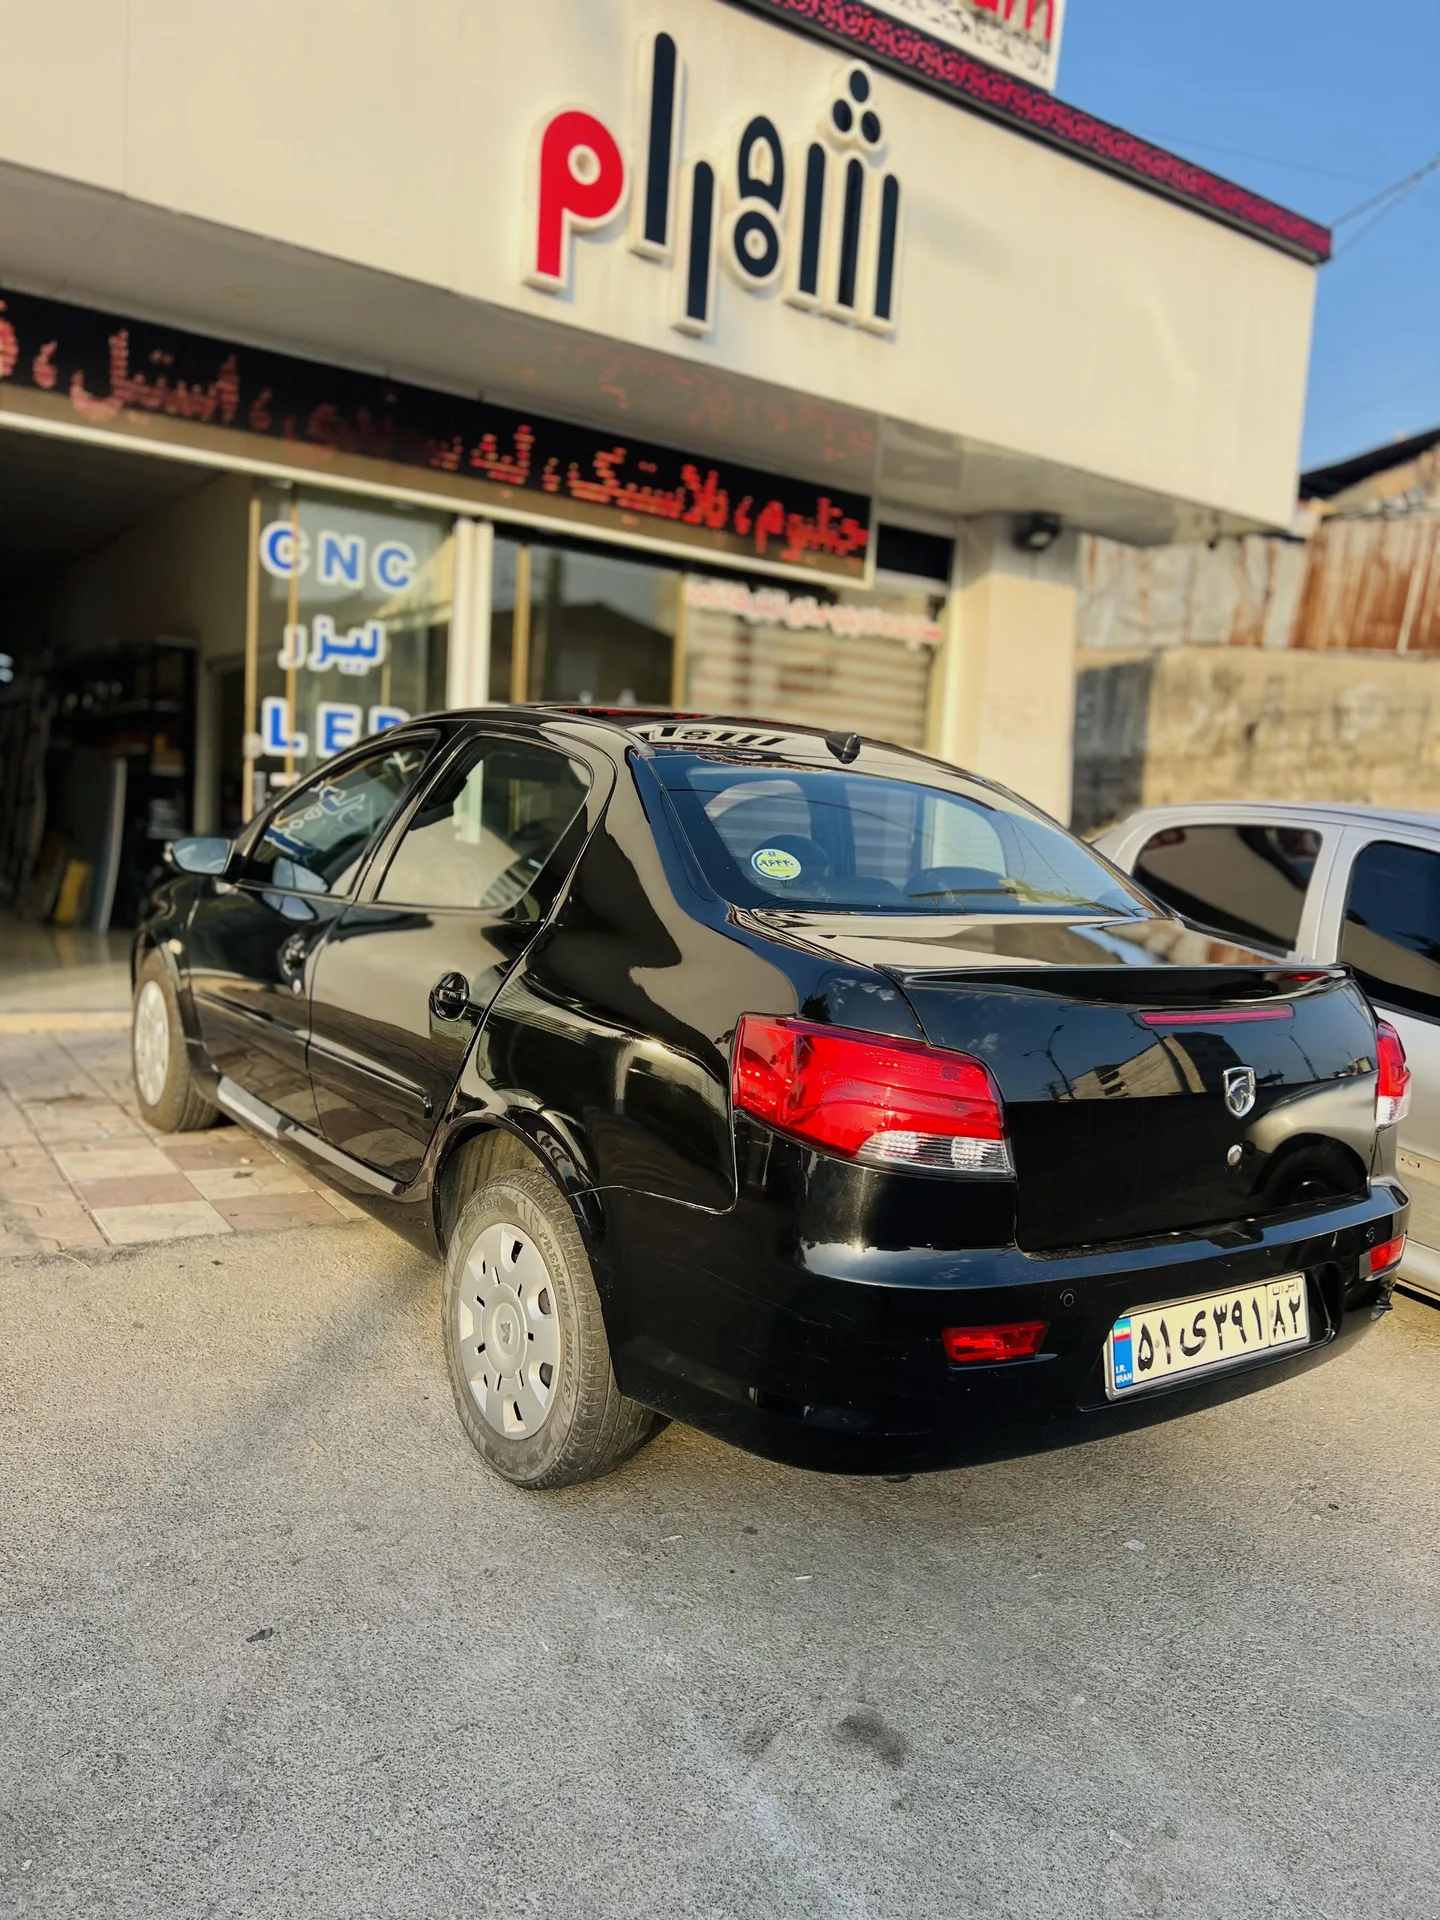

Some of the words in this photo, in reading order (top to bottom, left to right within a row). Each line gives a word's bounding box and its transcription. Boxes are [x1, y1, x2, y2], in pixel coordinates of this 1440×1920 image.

[532, 29, 903, 326] شهرام
[263, 527, 414, 589] CNC
[281, 616, 385, 672] لیزر
[538, 1229, 573, 1321] PREMIUM
[563, 1328, 574, 1399] DRIVE
[1272, 1294, 1301, 1340] ۸۲
[1115, 1371, 1133, 1383] IRAN
